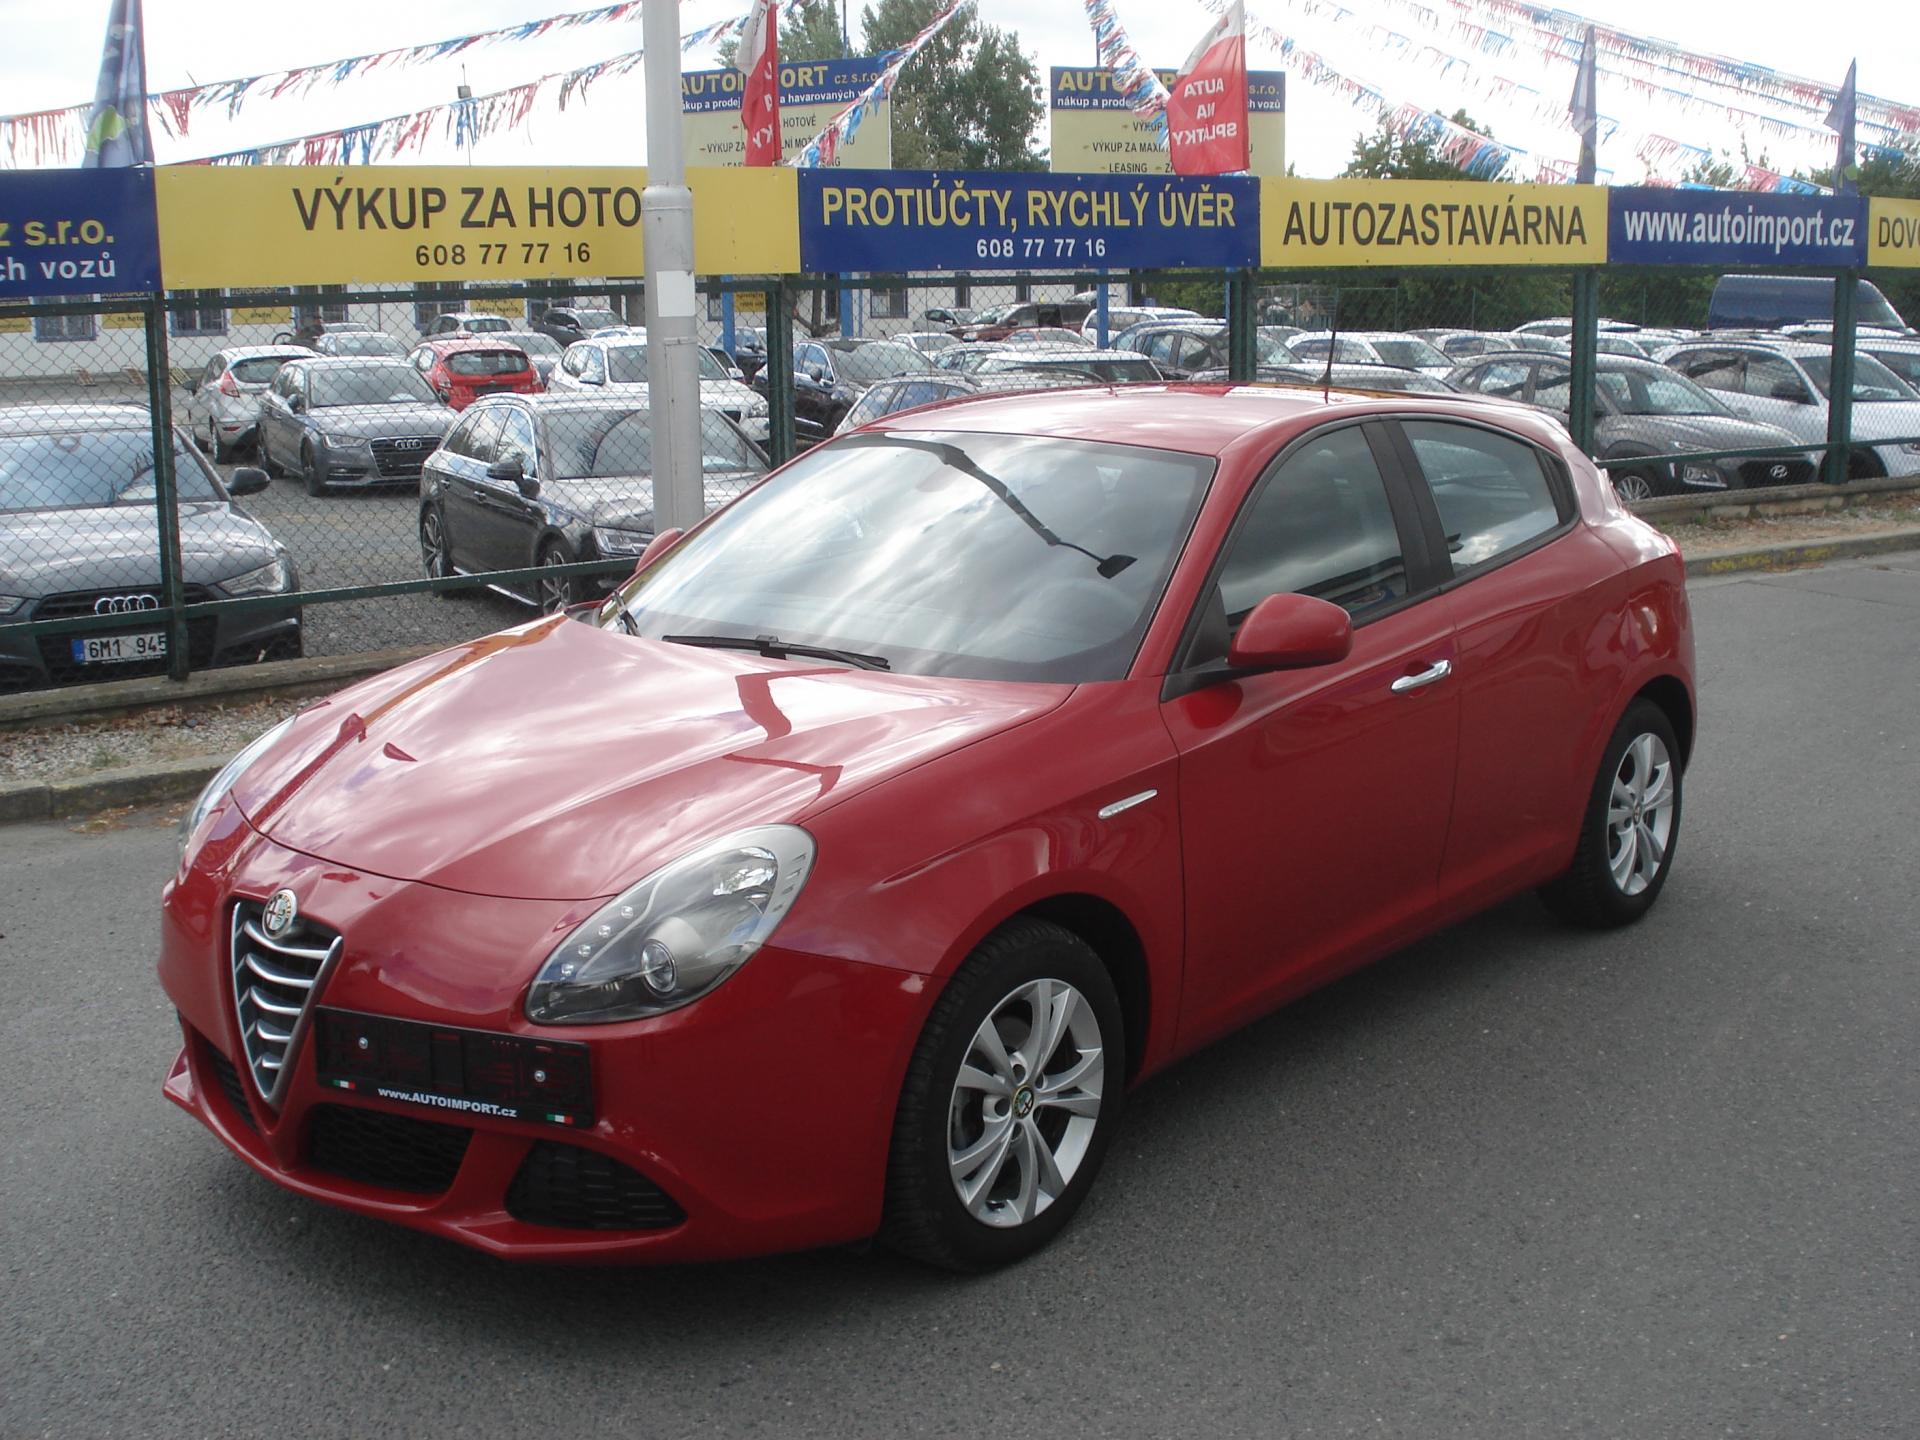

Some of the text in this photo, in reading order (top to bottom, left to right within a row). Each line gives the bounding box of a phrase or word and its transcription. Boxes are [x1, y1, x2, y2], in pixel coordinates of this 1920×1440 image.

[851, 73, 879, 83] s.r.o
[788, 89, 855, 103] havarovaných
[1057, 96, 1090, 108] nákup
[1258, 98, 1281, 109] vozů
[783, 115, 816, 129] HOTOVÉ
[1093, 140, 1122, 152] VÝKUP
[1125, 142, 1137, 152] ZA
[1109, 162, 1148, 173] LEASING
[292, 177, 643, 231] VÝKUP ZA HOTO
[822, 179, 1236, 233] PROTIÚČTY, RYCHLÝ ÚVĚR
[24, 219, 114, 246] s.r.o.
[1282, 195, 1588, 246] AUTOZASTAVÁRNA
[1624, 205, 1855, 255] www.autoimport.cz
[1879, 216, 1920, 248] DOV
[416, 242, 590, 266] 608 77 77 16
[976, 239, 1106, 258] 608 77 77 16
[40, 251, 116, 279] vozů
[89, 633, 167, 658] 6M1 945
[377, 1087, 517, 1118] www.AUTOIMPORT.cz
